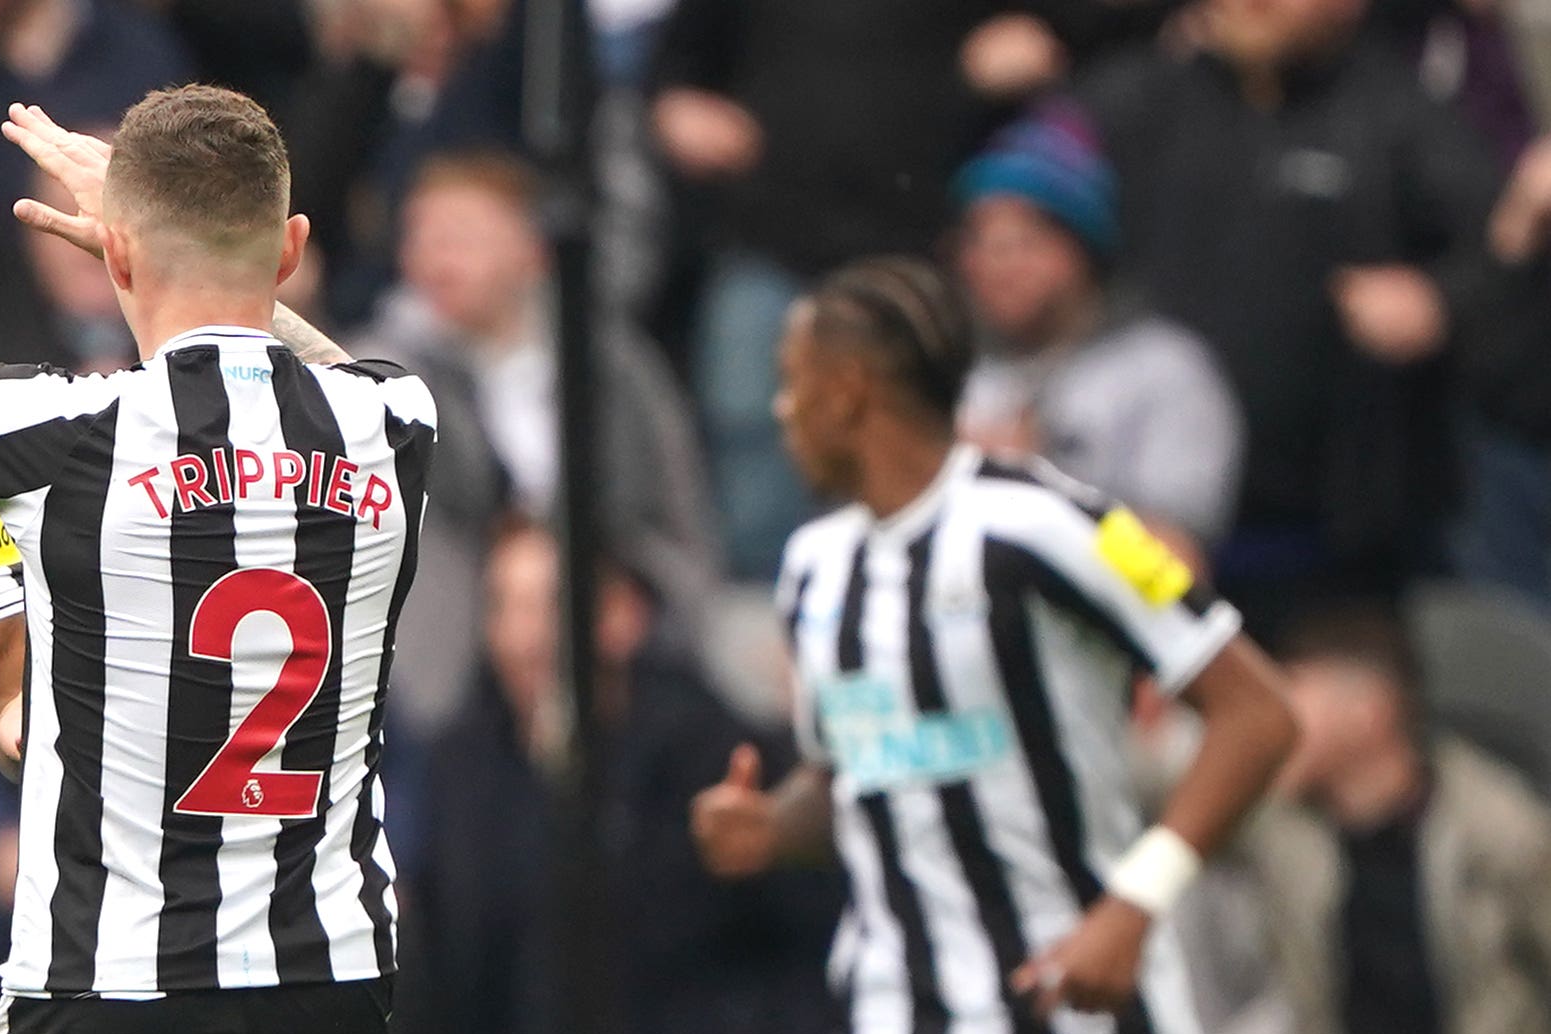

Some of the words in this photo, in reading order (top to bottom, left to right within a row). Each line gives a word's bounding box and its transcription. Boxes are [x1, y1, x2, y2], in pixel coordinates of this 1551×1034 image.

[224, 366, 272, 385] NUFC
[126, 446, 394, 532] TRIPPIER
[173, 567, 332, 819] 2
